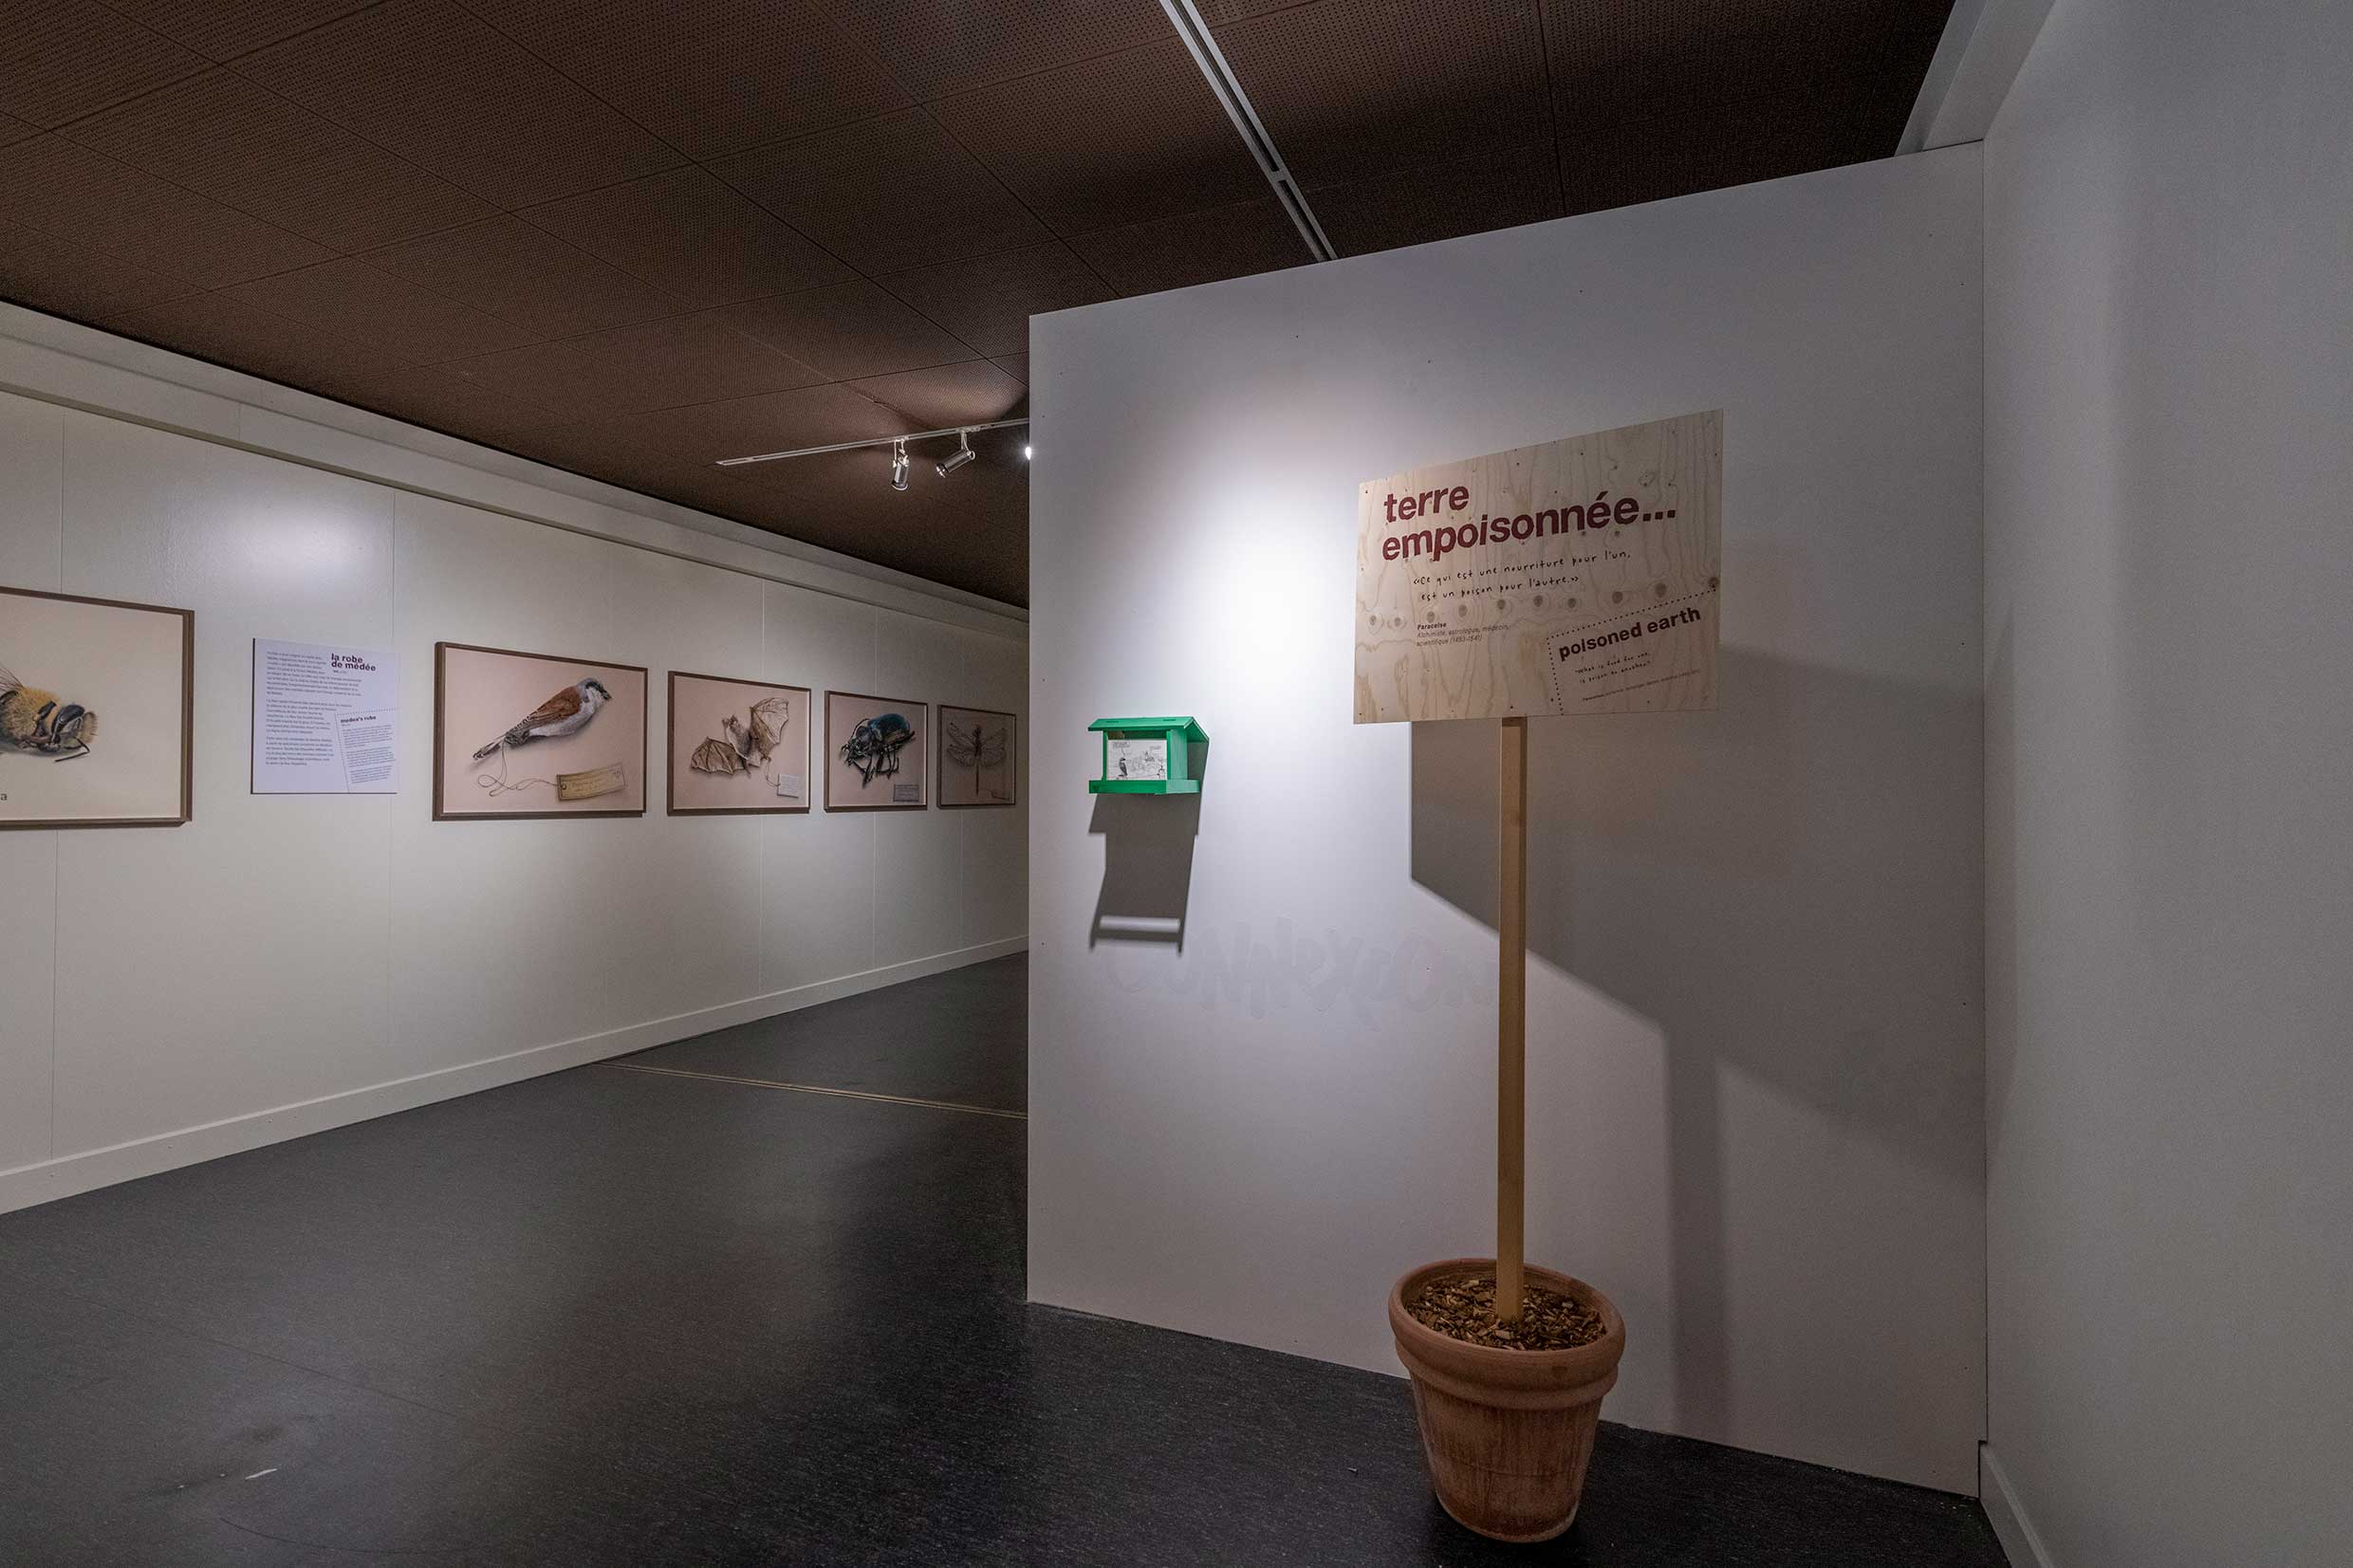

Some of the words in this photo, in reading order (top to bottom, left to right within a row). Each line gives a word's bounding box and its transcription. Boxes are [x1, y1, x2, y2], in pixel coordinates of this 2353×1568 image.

[1383, 486, 1470, 523] terre
[1382, 490, 1677, 562] empoisonnée...
[1436, 575, 1451, 586] qui
[1456, 570, 1473, 580] est
[1479, 567, 1497, 577] une
[1504, 558, 1565, 572] nourriture
[1571, 555, 1597, 566] pour
[1421, 592, 1436, 601] est
[1461, 586, 1492, 598] poison
[1499, 582, 1523, 593] pour
[1559, 621, 1642, 662] poisoned
[1647, 606, 1701, 634] earth
[331, 653, 340, 662] la
[342, 655, 363, 663] robe
[331, 660, 343, 669] de
[344, 662, 377, 672] médée
